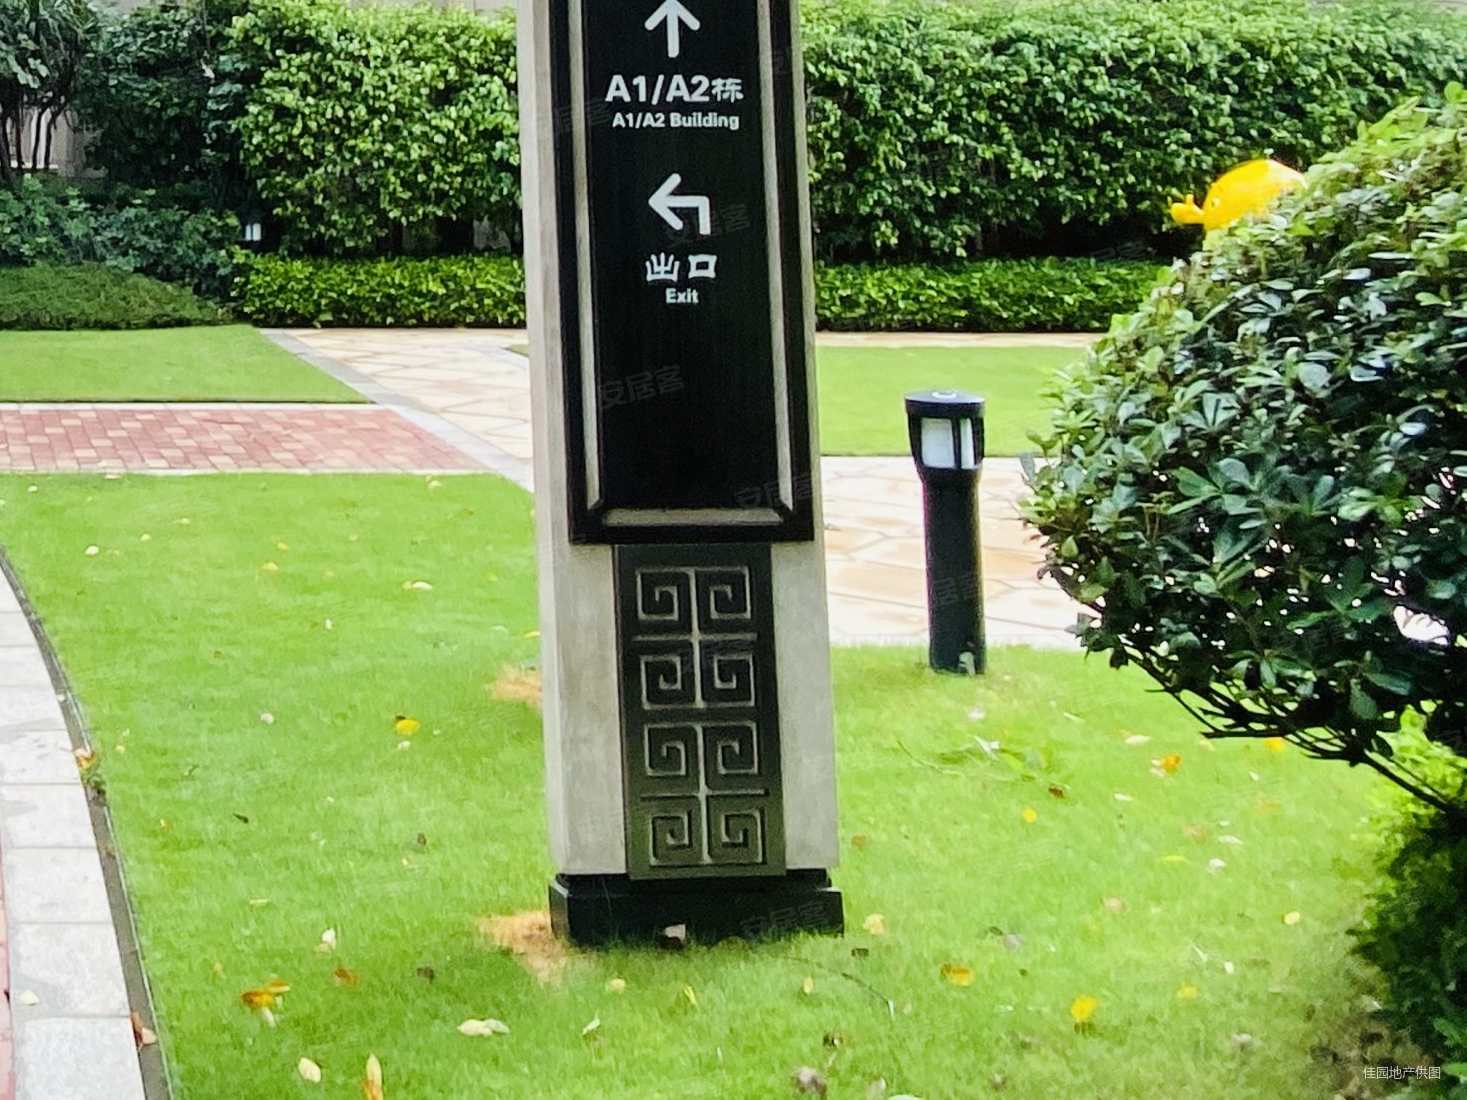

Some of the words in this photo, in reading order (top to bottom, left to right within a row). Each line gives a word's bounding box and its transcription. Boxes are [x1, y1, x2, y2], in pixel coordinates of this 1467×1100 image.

[604, 74, 745, 106] A1/A2栋
[612, 112, 666, 129] A1/A2
[669, 111, 741, 131] Building
[645, 251, 718, 283] 出口
[665, 287, 700, 304] Exit
